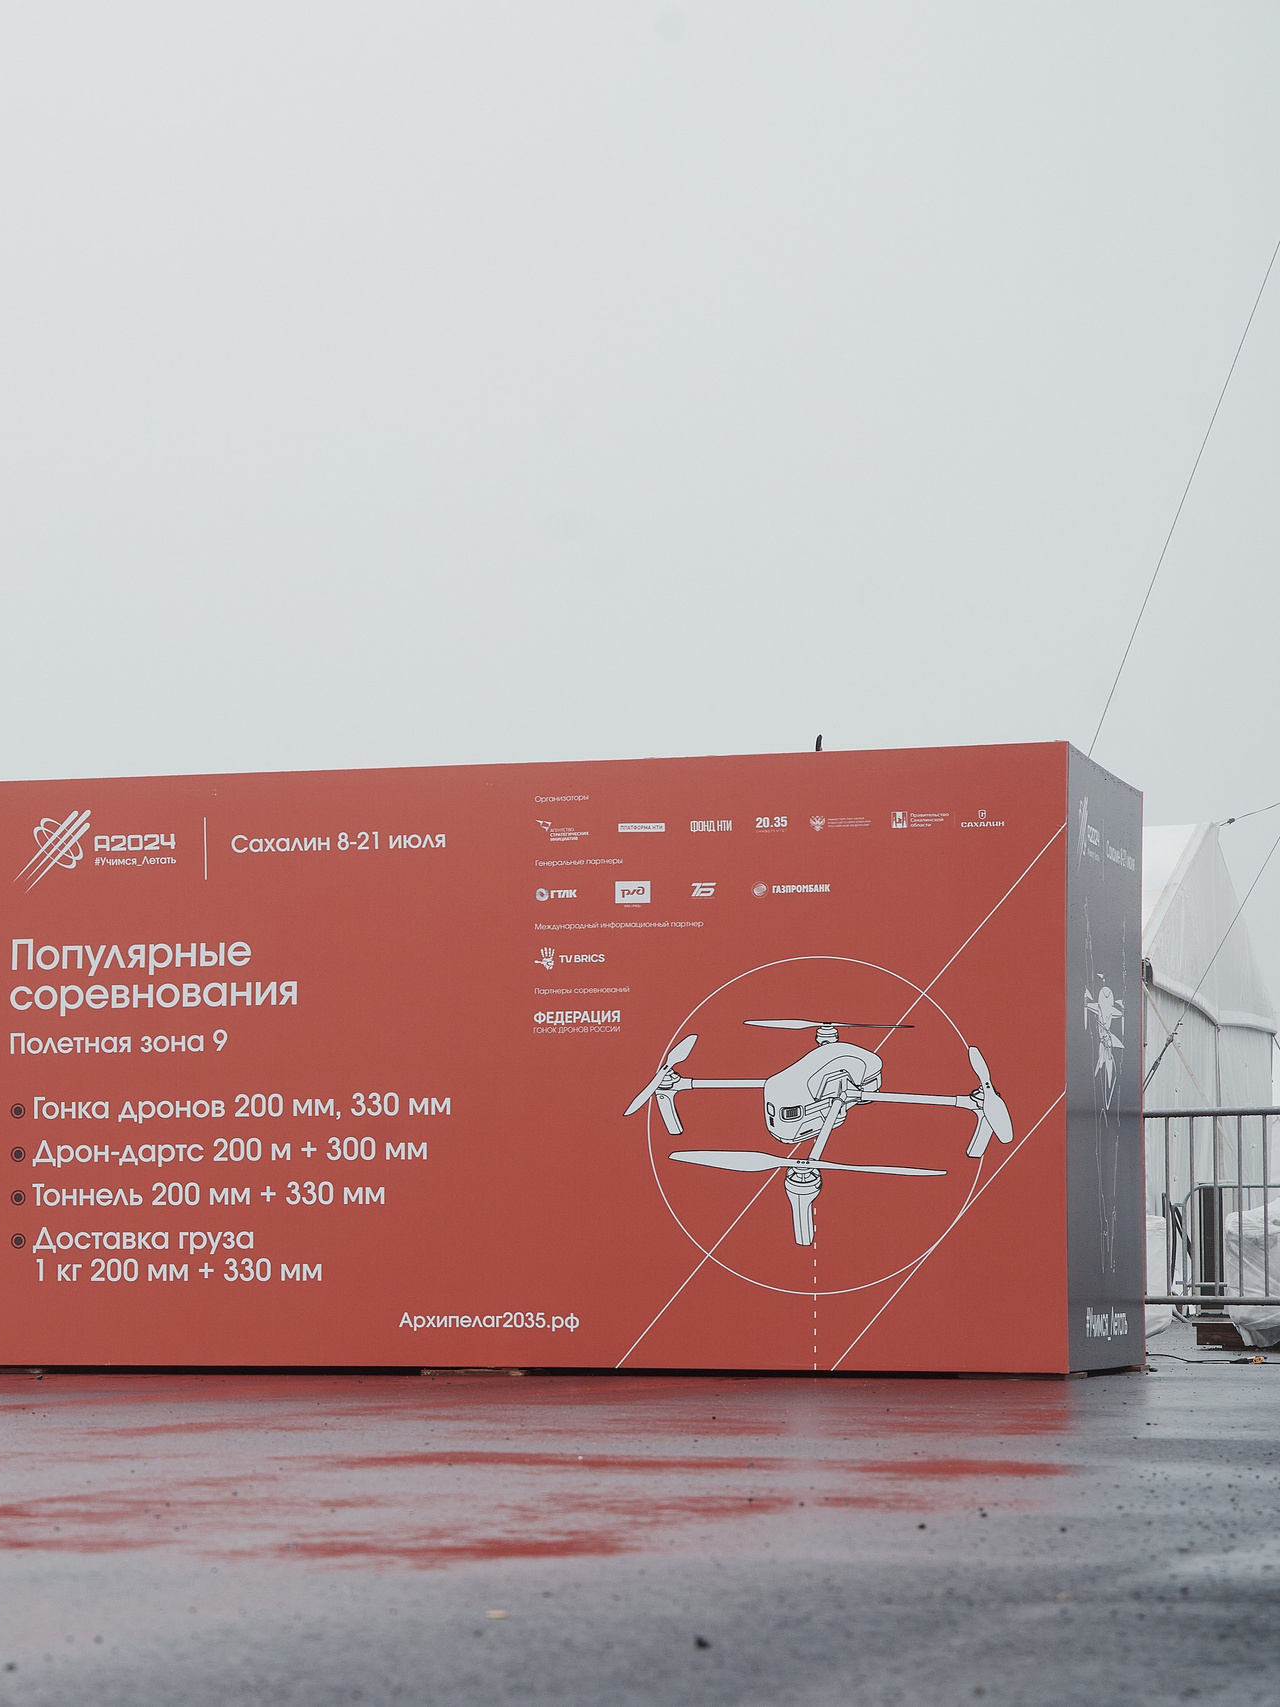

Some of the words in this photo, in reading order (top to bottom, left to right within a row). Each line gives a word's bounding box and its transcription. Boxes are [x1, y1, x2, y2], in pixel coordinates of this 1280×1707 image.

[534, 795, 590, 803] Организаторы
[690, 820, 716, 833] ФОНД
[716, 819, 733, 832] НТИ
[755, 815, 788, 829] 20.35
[960, 820, 1005, 829] САХАЛИН
[230, 833, 331, 854] Сахалин
[337, 831, 379, 852] 8-21
[388, 833, 446, 851] июля
[94, 855, 177, 868] #Учимся_Летать
[534, 859, 585, 867] Генеральные
[585, 858, 624, 866] партнеры
[550, 889, 578, 900] ГТЛК
[771, 883, 831, 895] ГАЗПРОМБАНК
[534, 921, 599, 931] Международный
[600, 921, 670, 930] информационный
[670, 920, 704, 929] партнер
[10, 938, 252, 976] Популярные
[558, 954, 573, 964] TV
[573, 953, 606, 964] BRICS
[534, 987, 573, 995] Партнеры
[573, 986, 631, 995] соревнований
[9, 980, 299, 1017] соревнования
[533, 1009, 621, 1026] ФЕДЕРАЦИЯ
[533, 1026, 557, 1034] ГОНОК
[558, 1026, 589, 1034] ДРОНОВ
[589, 1025, 621, 1033] РОССИИ
[9, 1032, 132, 1055] Полетная
[140, 1033, 205, 1053] зона
[212, 1028, 228, 1052] 9
[33, 1096, 110, 1120] Гонка
[117, 1098, 226, 1125] дронов
[234, 1092, 284, 1118] 200
[292, 1098, 342, 1121] мм,
[350, 1091, 400, 1117] 330
[408, 1096, 451, 1116] мм
[32, 1139, 205, 1169] Дрон-дартс
[212, 1137, 262, 1162] 200
[271, 1142, 291, 1161] м
[300, 1141, 318, 1158] +
[326, 1136, 376, 1161] 300
[385, 1141, 428, 1161] мм
[32, 1182, 144, 1207] Тоннель
[151, 1181, 201, 1206] 200
[209, 1187, 251, 1206] мм
[260, 1185, 277, 1203] +
[285, 1180, 334, 1206] 330
[343, 1186, 386, 1205] мм
[32, 1226, 169, 1254] Доставка
[178, 1230, 254, 1255] груза
[35, 1258, 45, 1282] 1
[57, 1263, 83, 1282] кг
[90, 1257, 139, 1283] 200
[147, 1263, 189, 1282] мм
[198, 1262, 215, 1279] +
[223, 1257, 272, 1282] 330
[280, 1263, 323, 1282] мм
[398, 1310, 580, 1333] Архипелаг2035.рф
